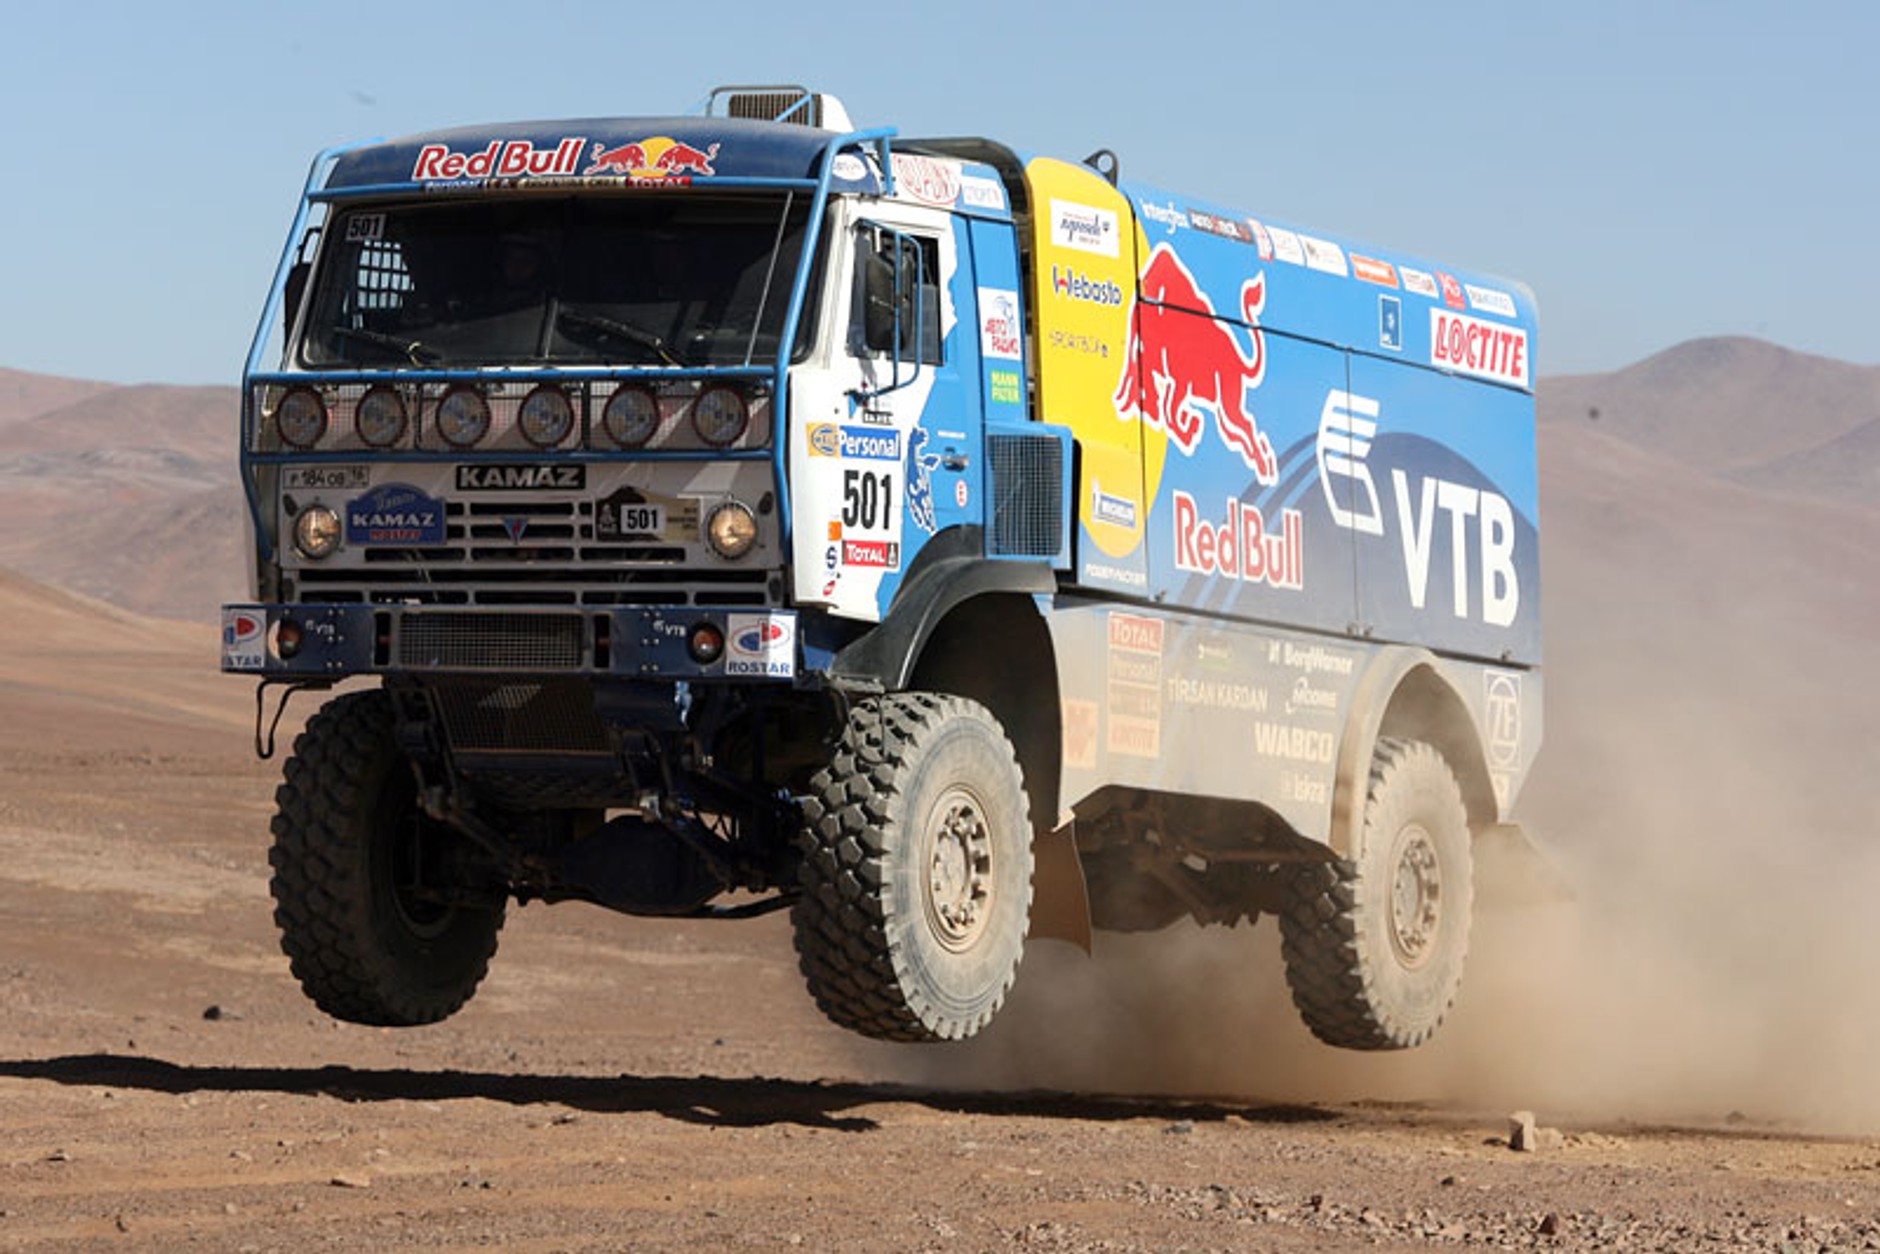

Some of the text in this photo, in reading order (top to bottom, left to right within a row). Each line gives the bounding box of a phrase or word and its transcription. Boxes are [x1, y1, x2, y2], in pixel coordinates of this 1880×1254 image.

[412, 137, 586, 181] Red Bull
[350, 217, 380, 238] 501
[1052, 264, 1122, 305] Webasto
[1434, 315, 1524, 378] LOCTITE
[839, 428, 899, 457] Personal
[459, 467, 580, 488] KAMAZ
[842, 470, 892, 530] 501
[352, 513, 435, 527] KAMAZ
[626, 508, 659, 530] 501
[846, 544, 885, 563] TOTAL
[1172, 489, 1304, 590] Red Bull
[1391, 468, 1520, 628] VTB
[664, 624, 687, 637] VTB
[1110, 617, 1160, 648] TOTAL
[728, 660, 790, 674] ROSTAR
[1255, 721, 1335, 764] WABCO
